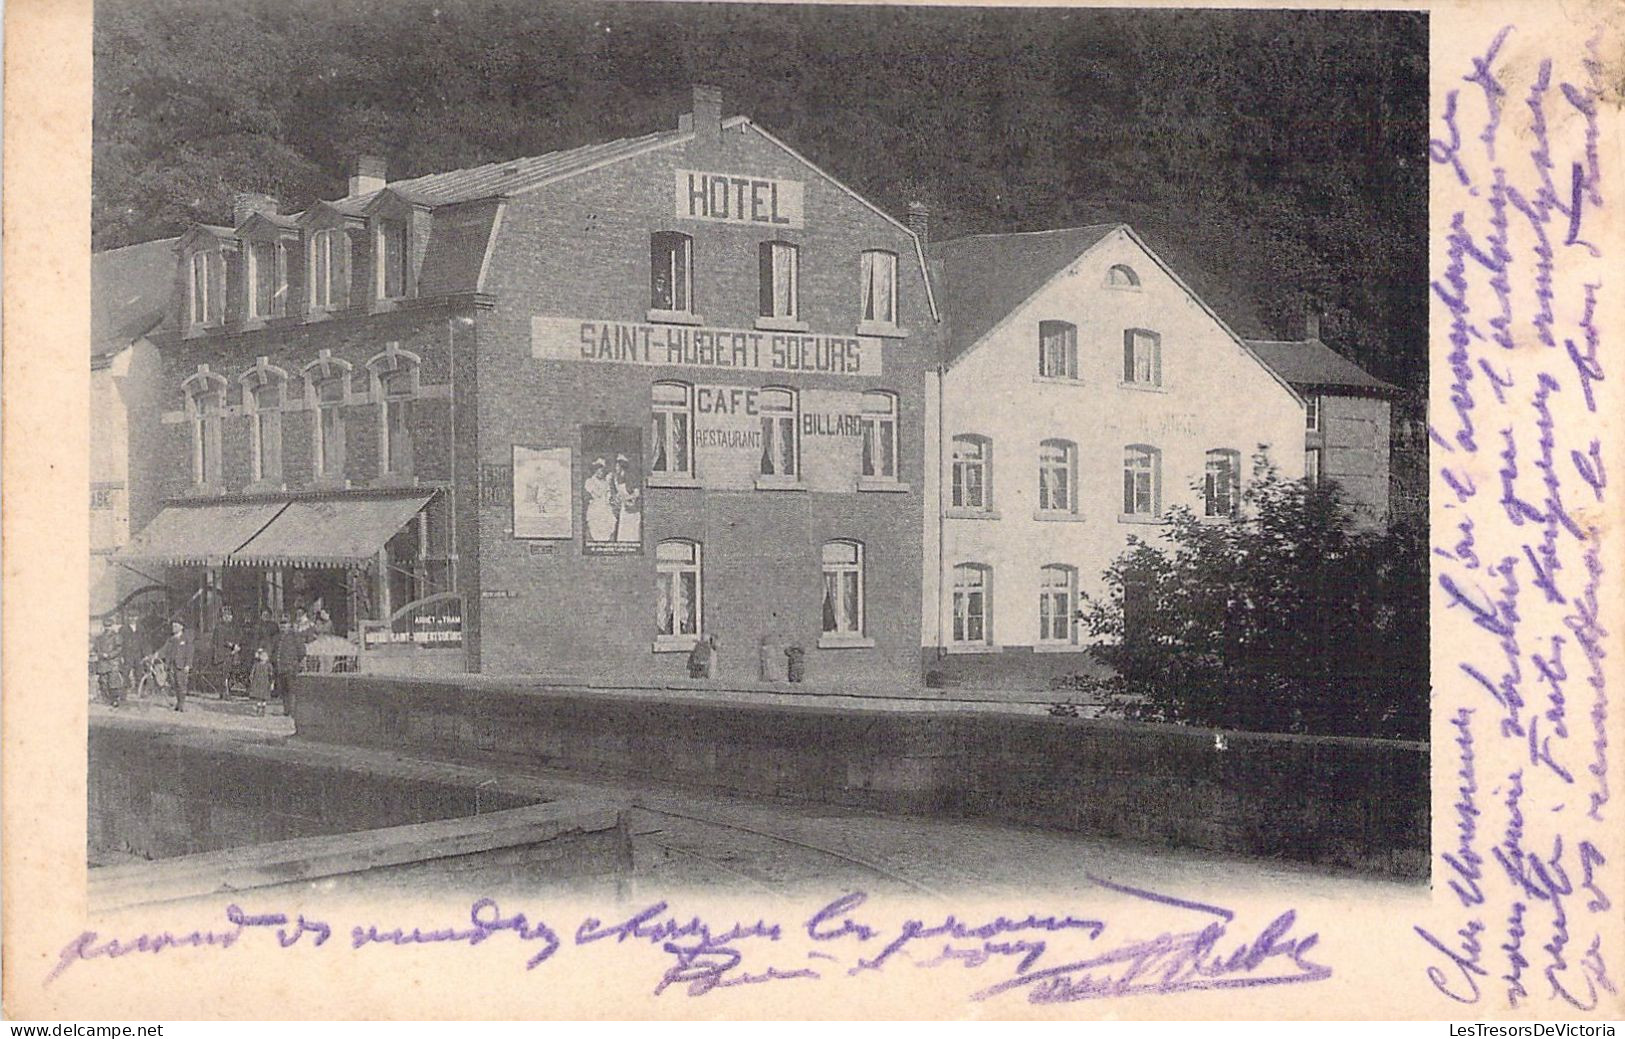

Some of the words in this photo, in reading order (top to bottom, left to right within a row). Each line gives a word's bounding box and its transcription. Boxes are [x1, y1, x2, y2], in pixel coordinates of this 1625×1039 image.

[688, 174, 790, 224] HOTEL
[580, 322, 763, 368] SAINT-HUBERT
[772, 335, 861, 372] SOEURS
[697, 388, 759, 415] CAFE
[803, 413, 862, 436] BILLARD
[695, 428, 761, 449] RESTAURANT
